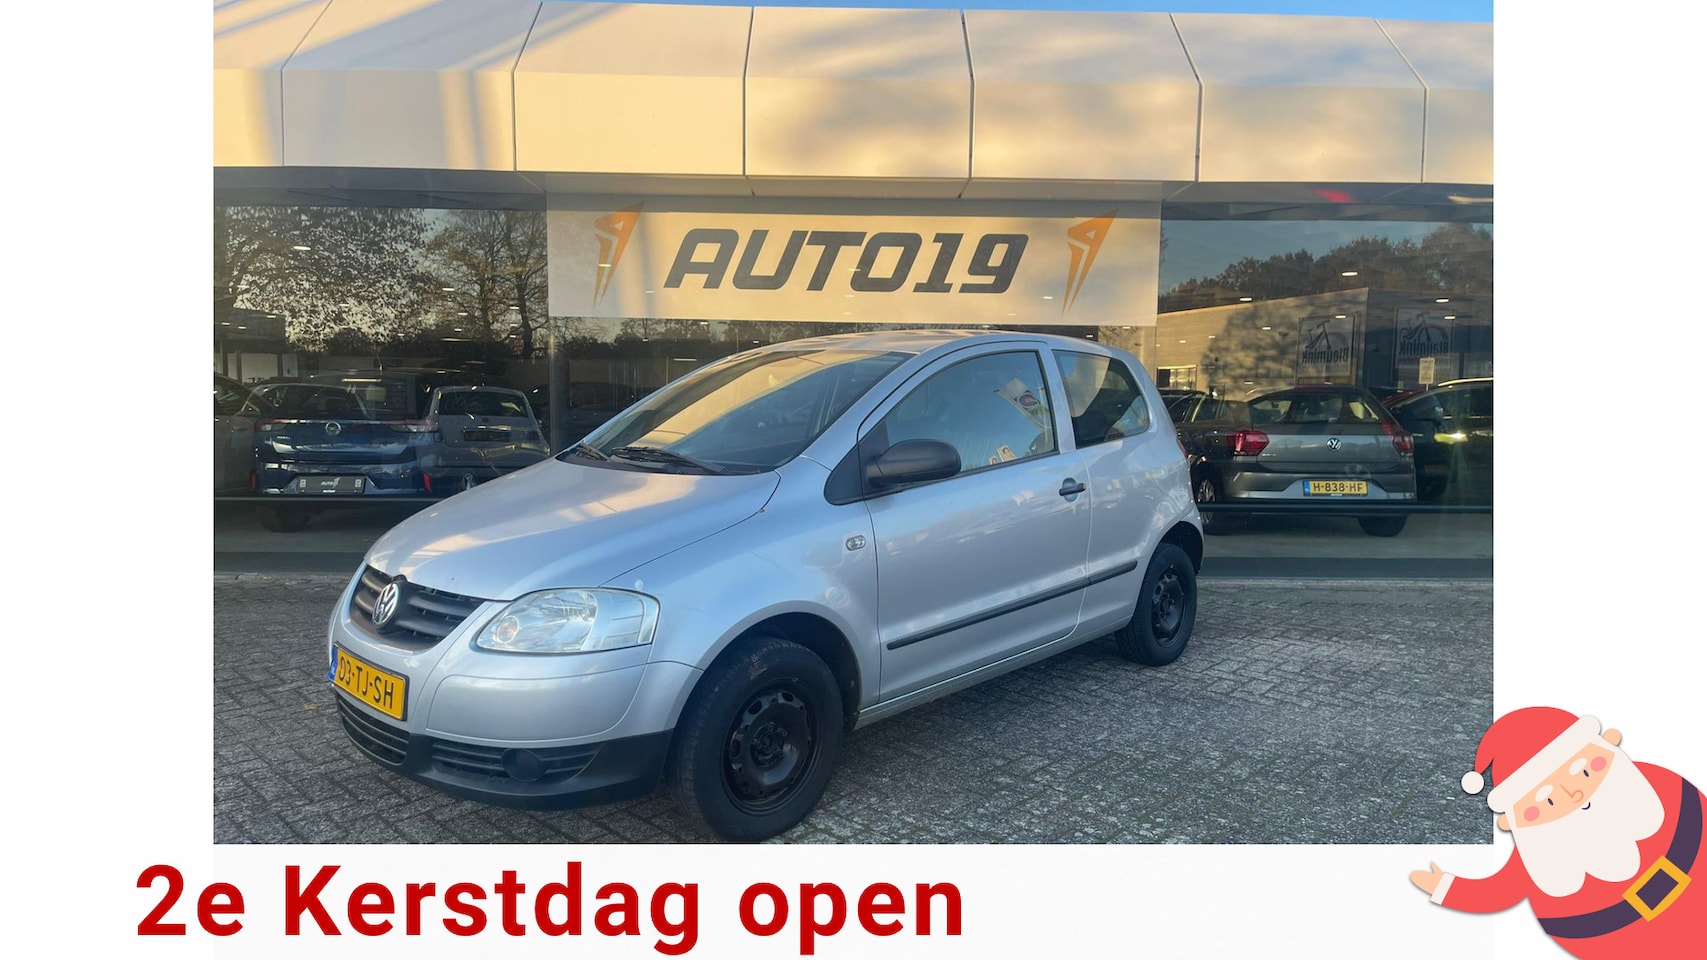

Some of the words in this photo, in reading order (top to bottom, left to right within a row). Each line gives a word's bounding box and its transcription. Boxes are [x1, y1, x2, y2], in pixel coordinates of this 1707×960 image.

[663, 228, 1029, 294] AUTO19
[1313, 482, 1363, 492] H-838-HF
[338, 656, 394, 709] 03-TJ-SH
